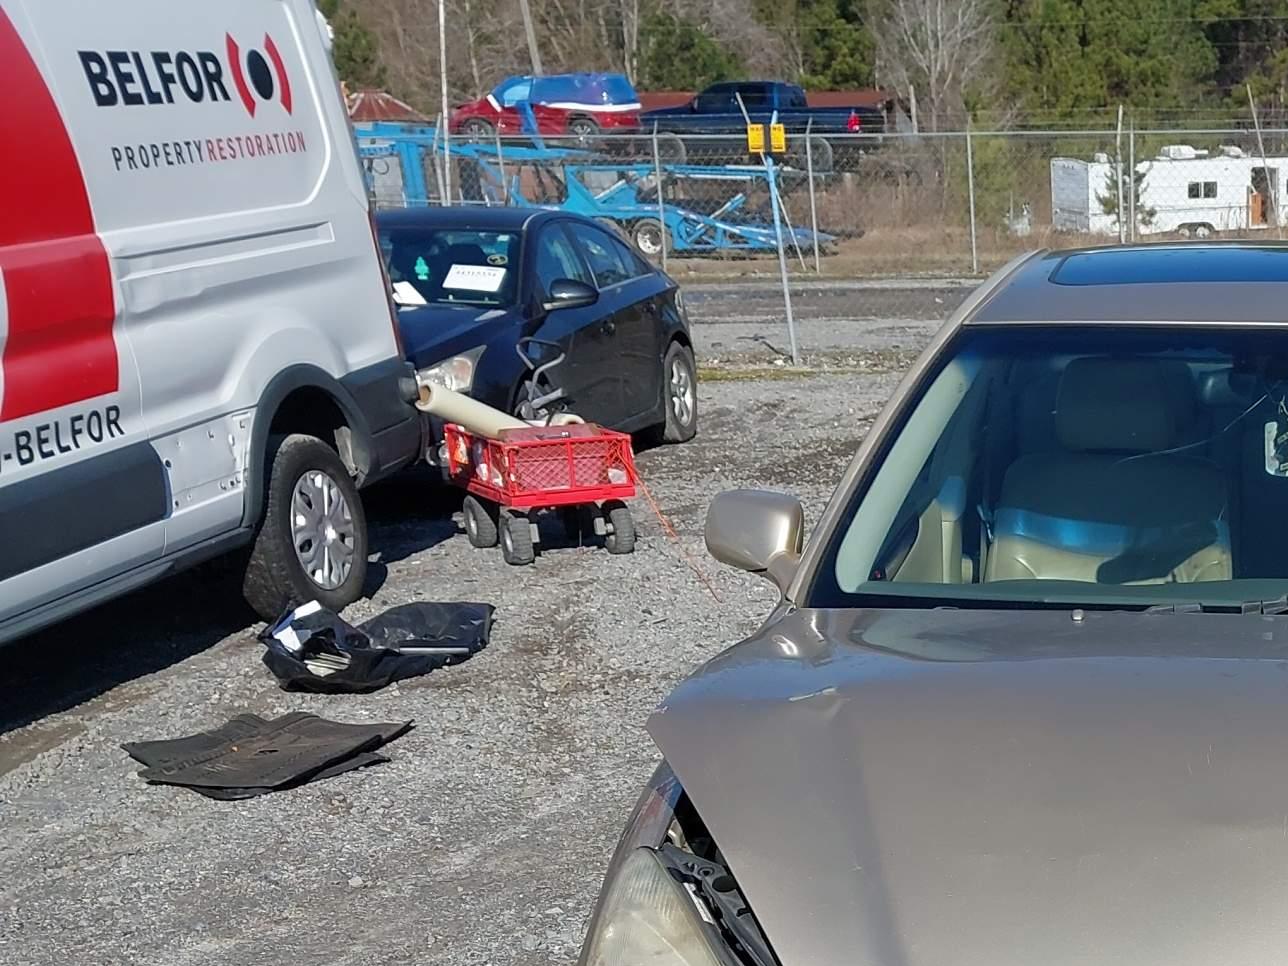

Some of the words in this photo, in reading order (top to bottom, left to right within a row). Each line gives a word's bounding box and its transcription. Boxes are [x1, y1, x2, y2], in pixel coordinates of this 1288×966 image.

[77, 50, 231, 106] BELFOR
[111, 139, 204, 171] PROPERTY
[205, 131, 306, 161] RESTORATION
[0, 405, 125, 468] -BELFOR
